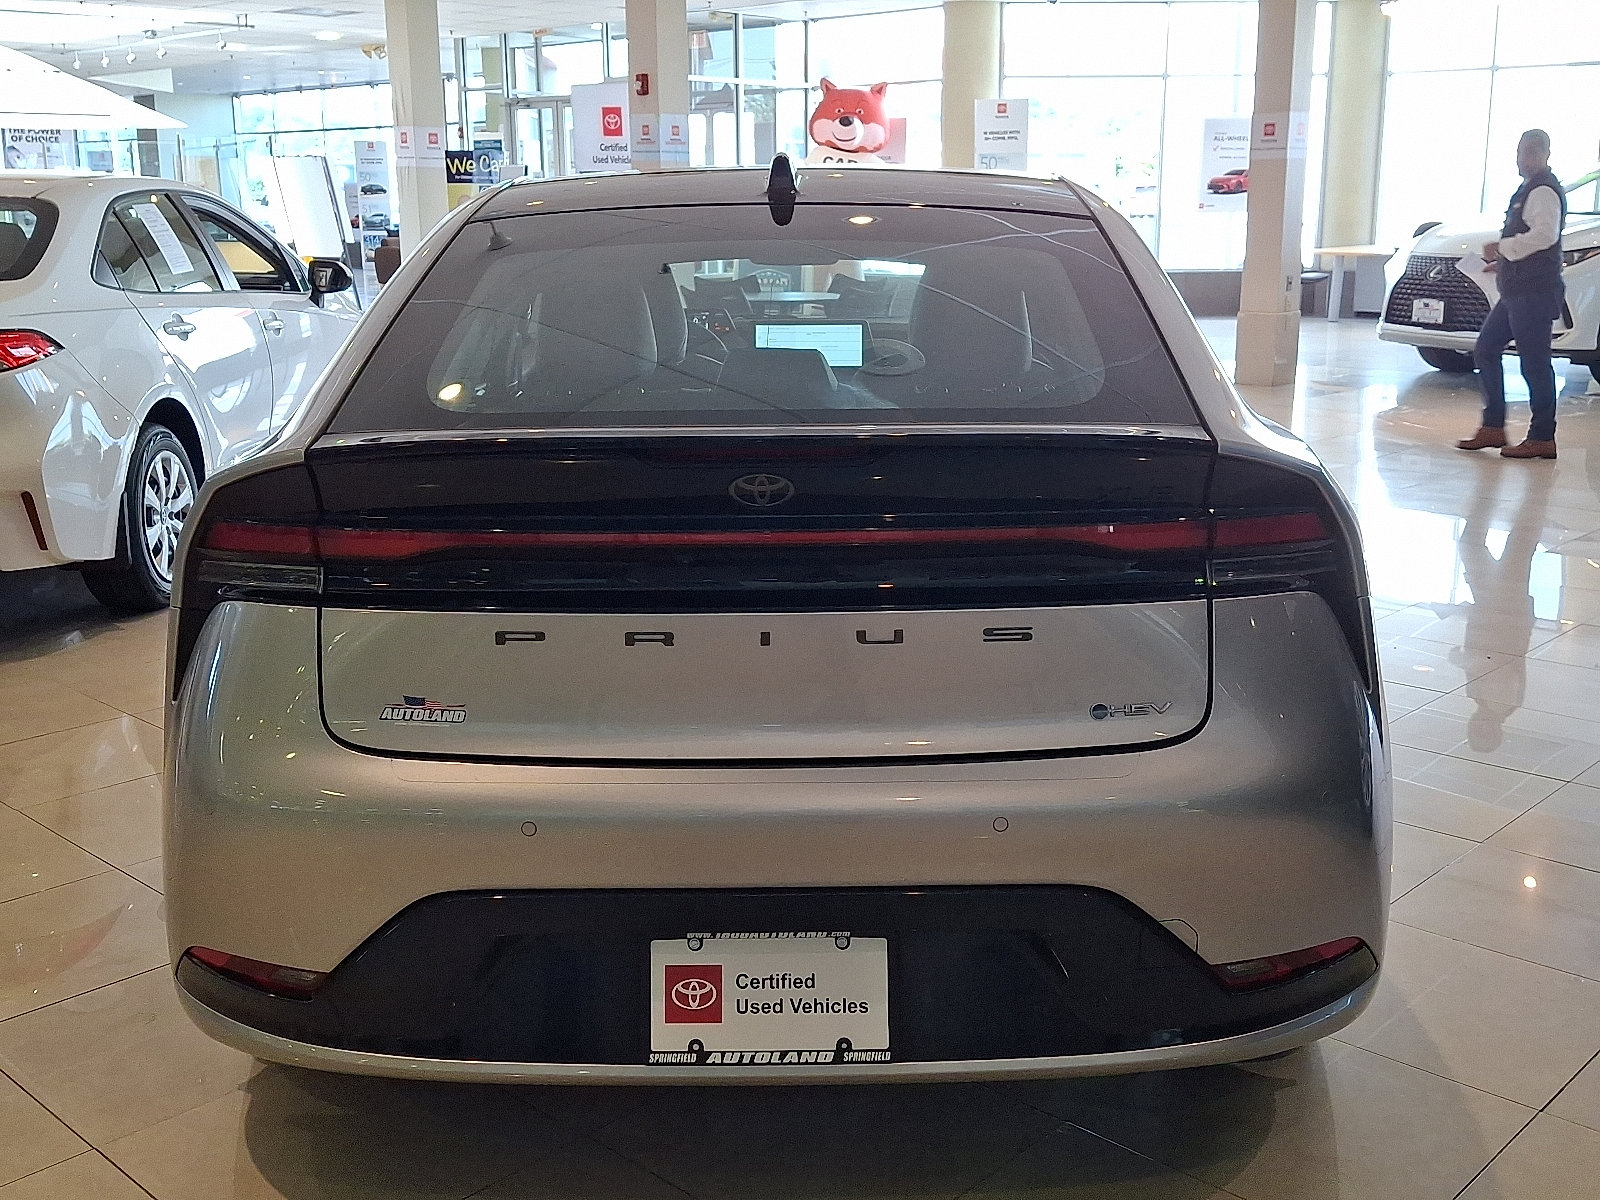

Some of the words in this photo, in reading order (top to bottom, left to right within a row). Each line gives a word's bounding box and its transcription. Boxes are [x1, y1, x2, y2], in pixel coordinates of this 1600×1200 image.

[25, 135, 60, 143] CHOICE
[599, 143, 628, 152] Certified
[446, 156, 477, 175] We
[592, 155, 609, 164] Used
[495, 626, 1034, 647] PRIUS
[379, 706, 466, 723] AUTOLAND
[1109, 701, 1173, 717] HEV
[735, 972, 816, 989] Certified
[735, 997, 784, 1014] Used
[789, 997, 869, 1014] Vehicles
[649, 1052, 697, 1063] SPRINGFIELD
[706, 1051, 835, 1064] AUTOLAND
[843, 1051, 891, 1061] SPRINGFIELD
